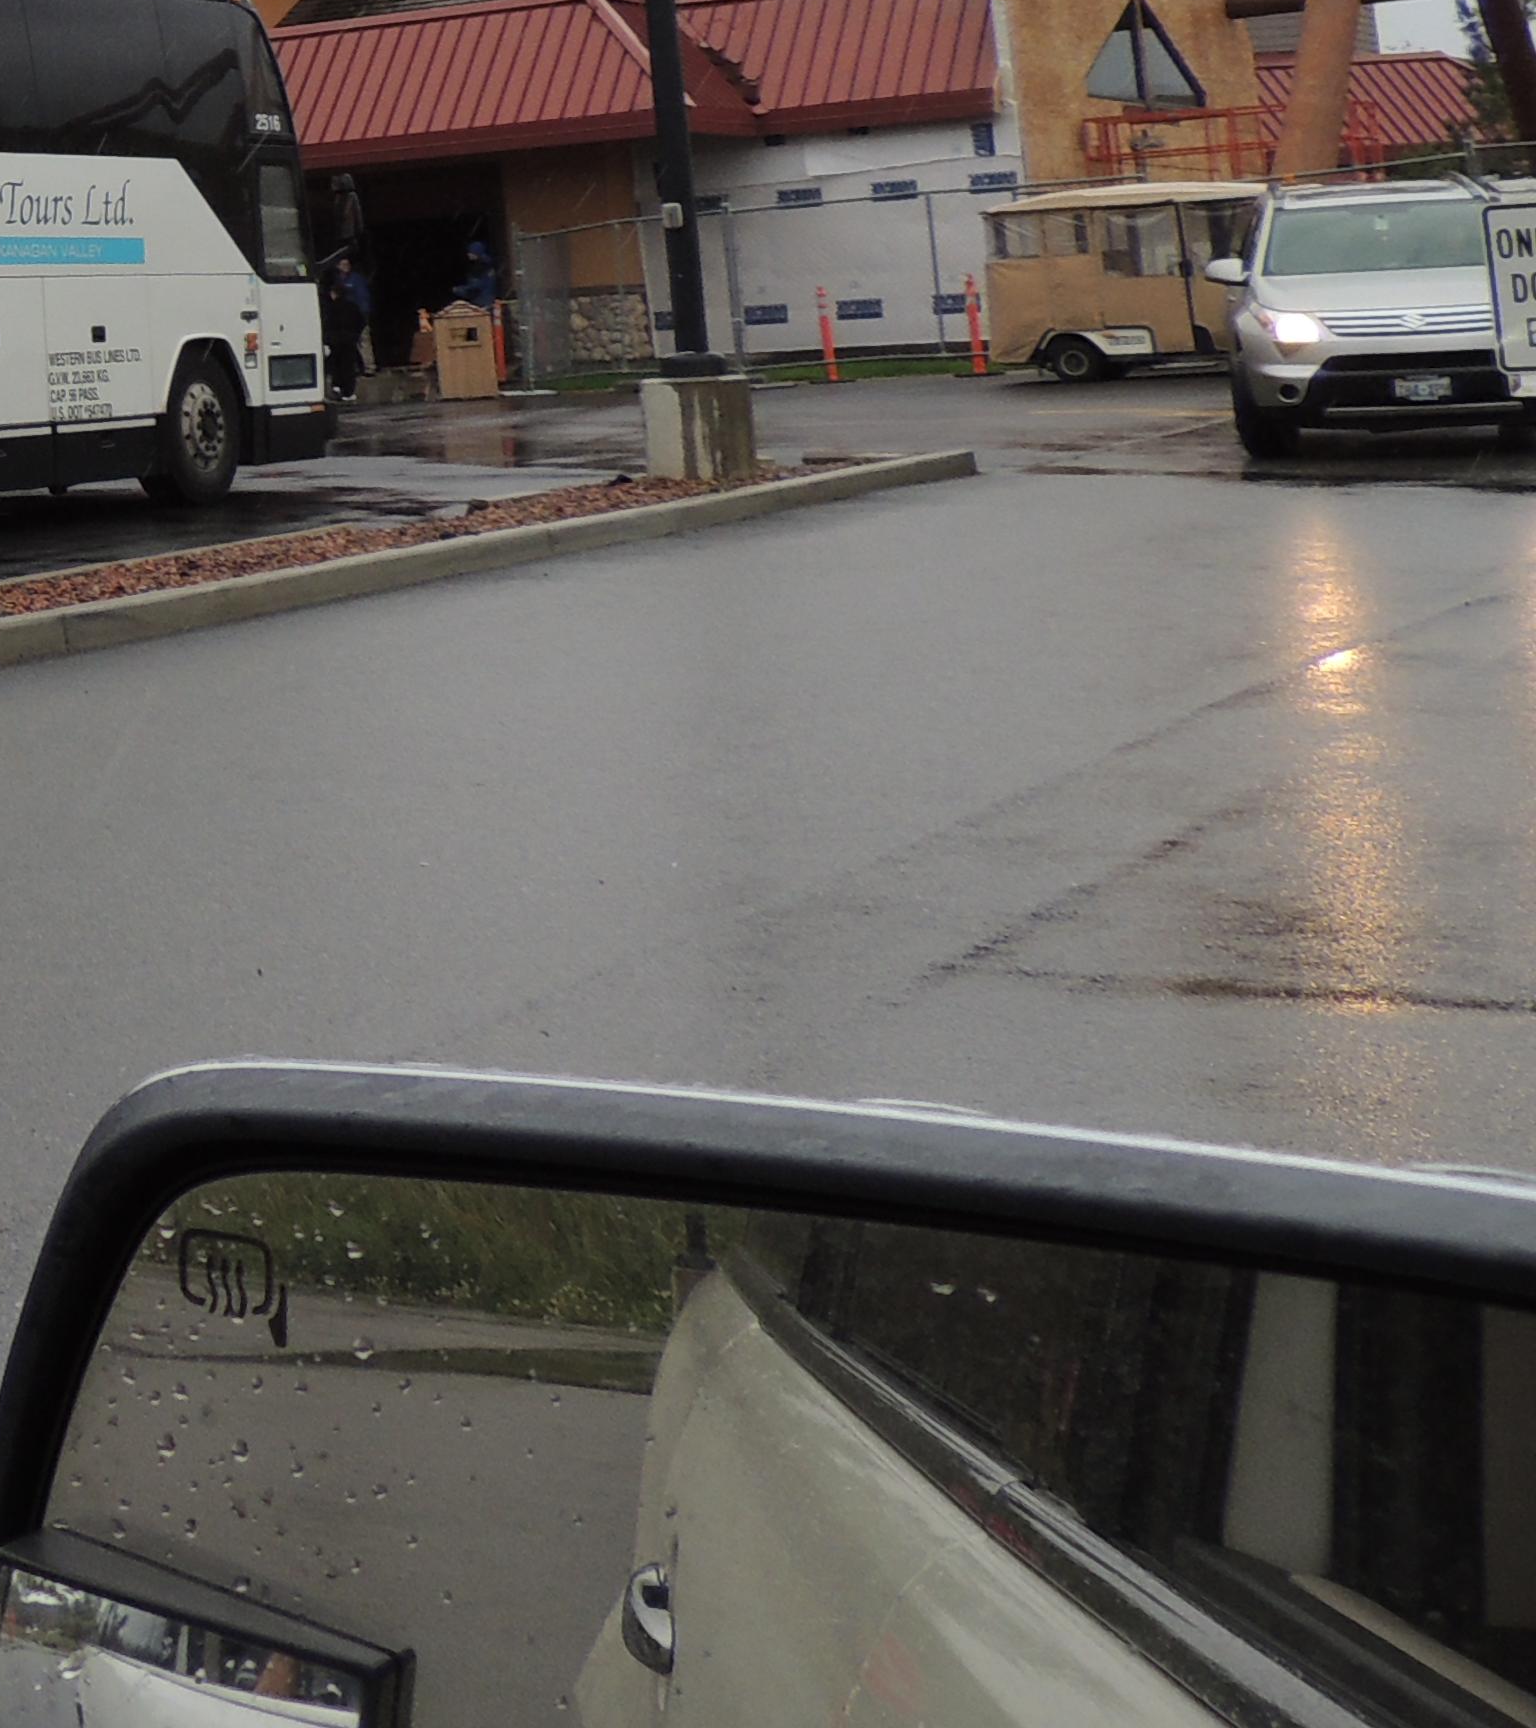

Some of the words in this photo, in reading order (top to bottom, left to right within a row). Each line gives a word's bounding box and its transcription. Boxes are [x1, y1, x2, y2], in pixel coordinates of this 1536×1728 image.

[0, 179, 74, 225] Tours
[81, 179, 135, 226] Ltd.
[61, 243, 103, 257] VALLEY
[1496, 228, 1536, 259] ON
